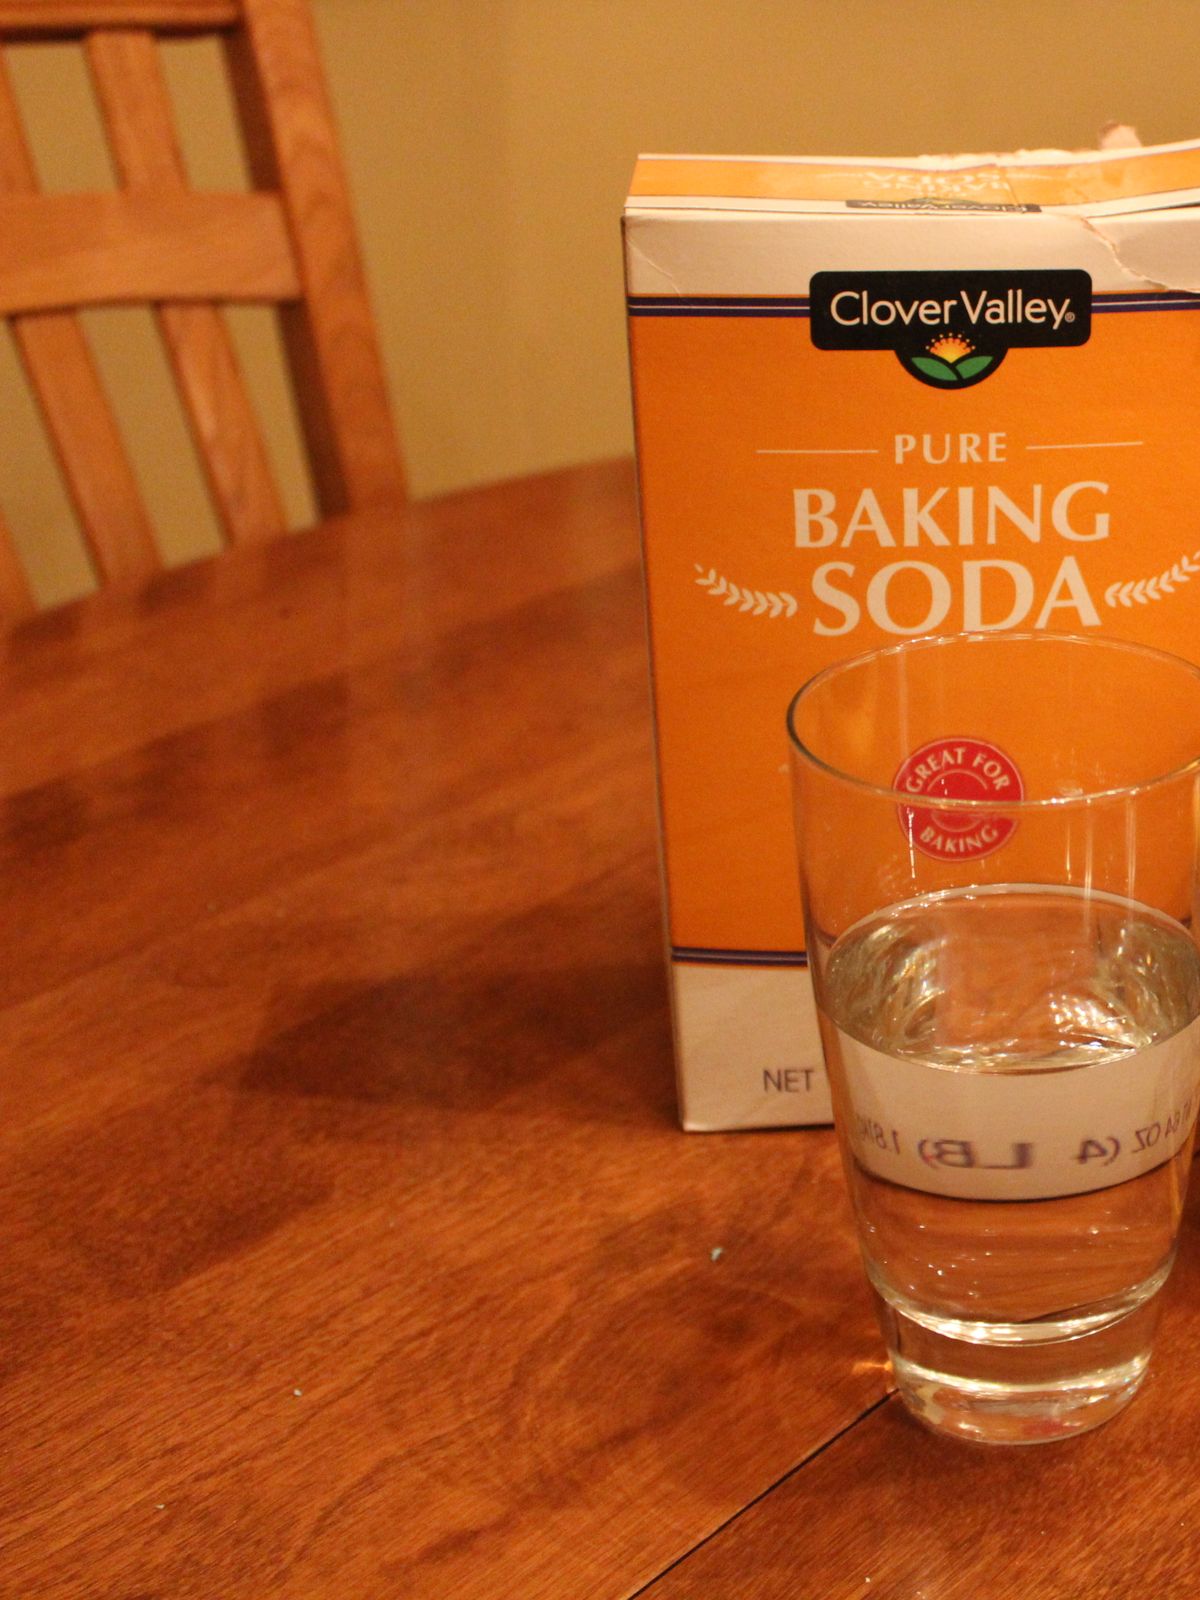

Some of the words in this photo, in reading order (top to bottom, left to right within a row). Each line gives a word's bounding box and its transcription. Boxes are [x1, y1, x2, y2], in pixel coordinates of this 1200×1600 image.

[830, 290, 958, 326] Clover
[960, 289, 1071, 330] Valley
[894, 432, 1008, 464] PURE
[792, 481, 1111, 548] BAKING
[811, 556, 1102, 636] SODA
[905, 747, 967, 793] GREAT
[972, 752, 1011, 791] FOR
[920, 825, 999, 853] BAKING
[763, 1068, 815, 1093] NET
